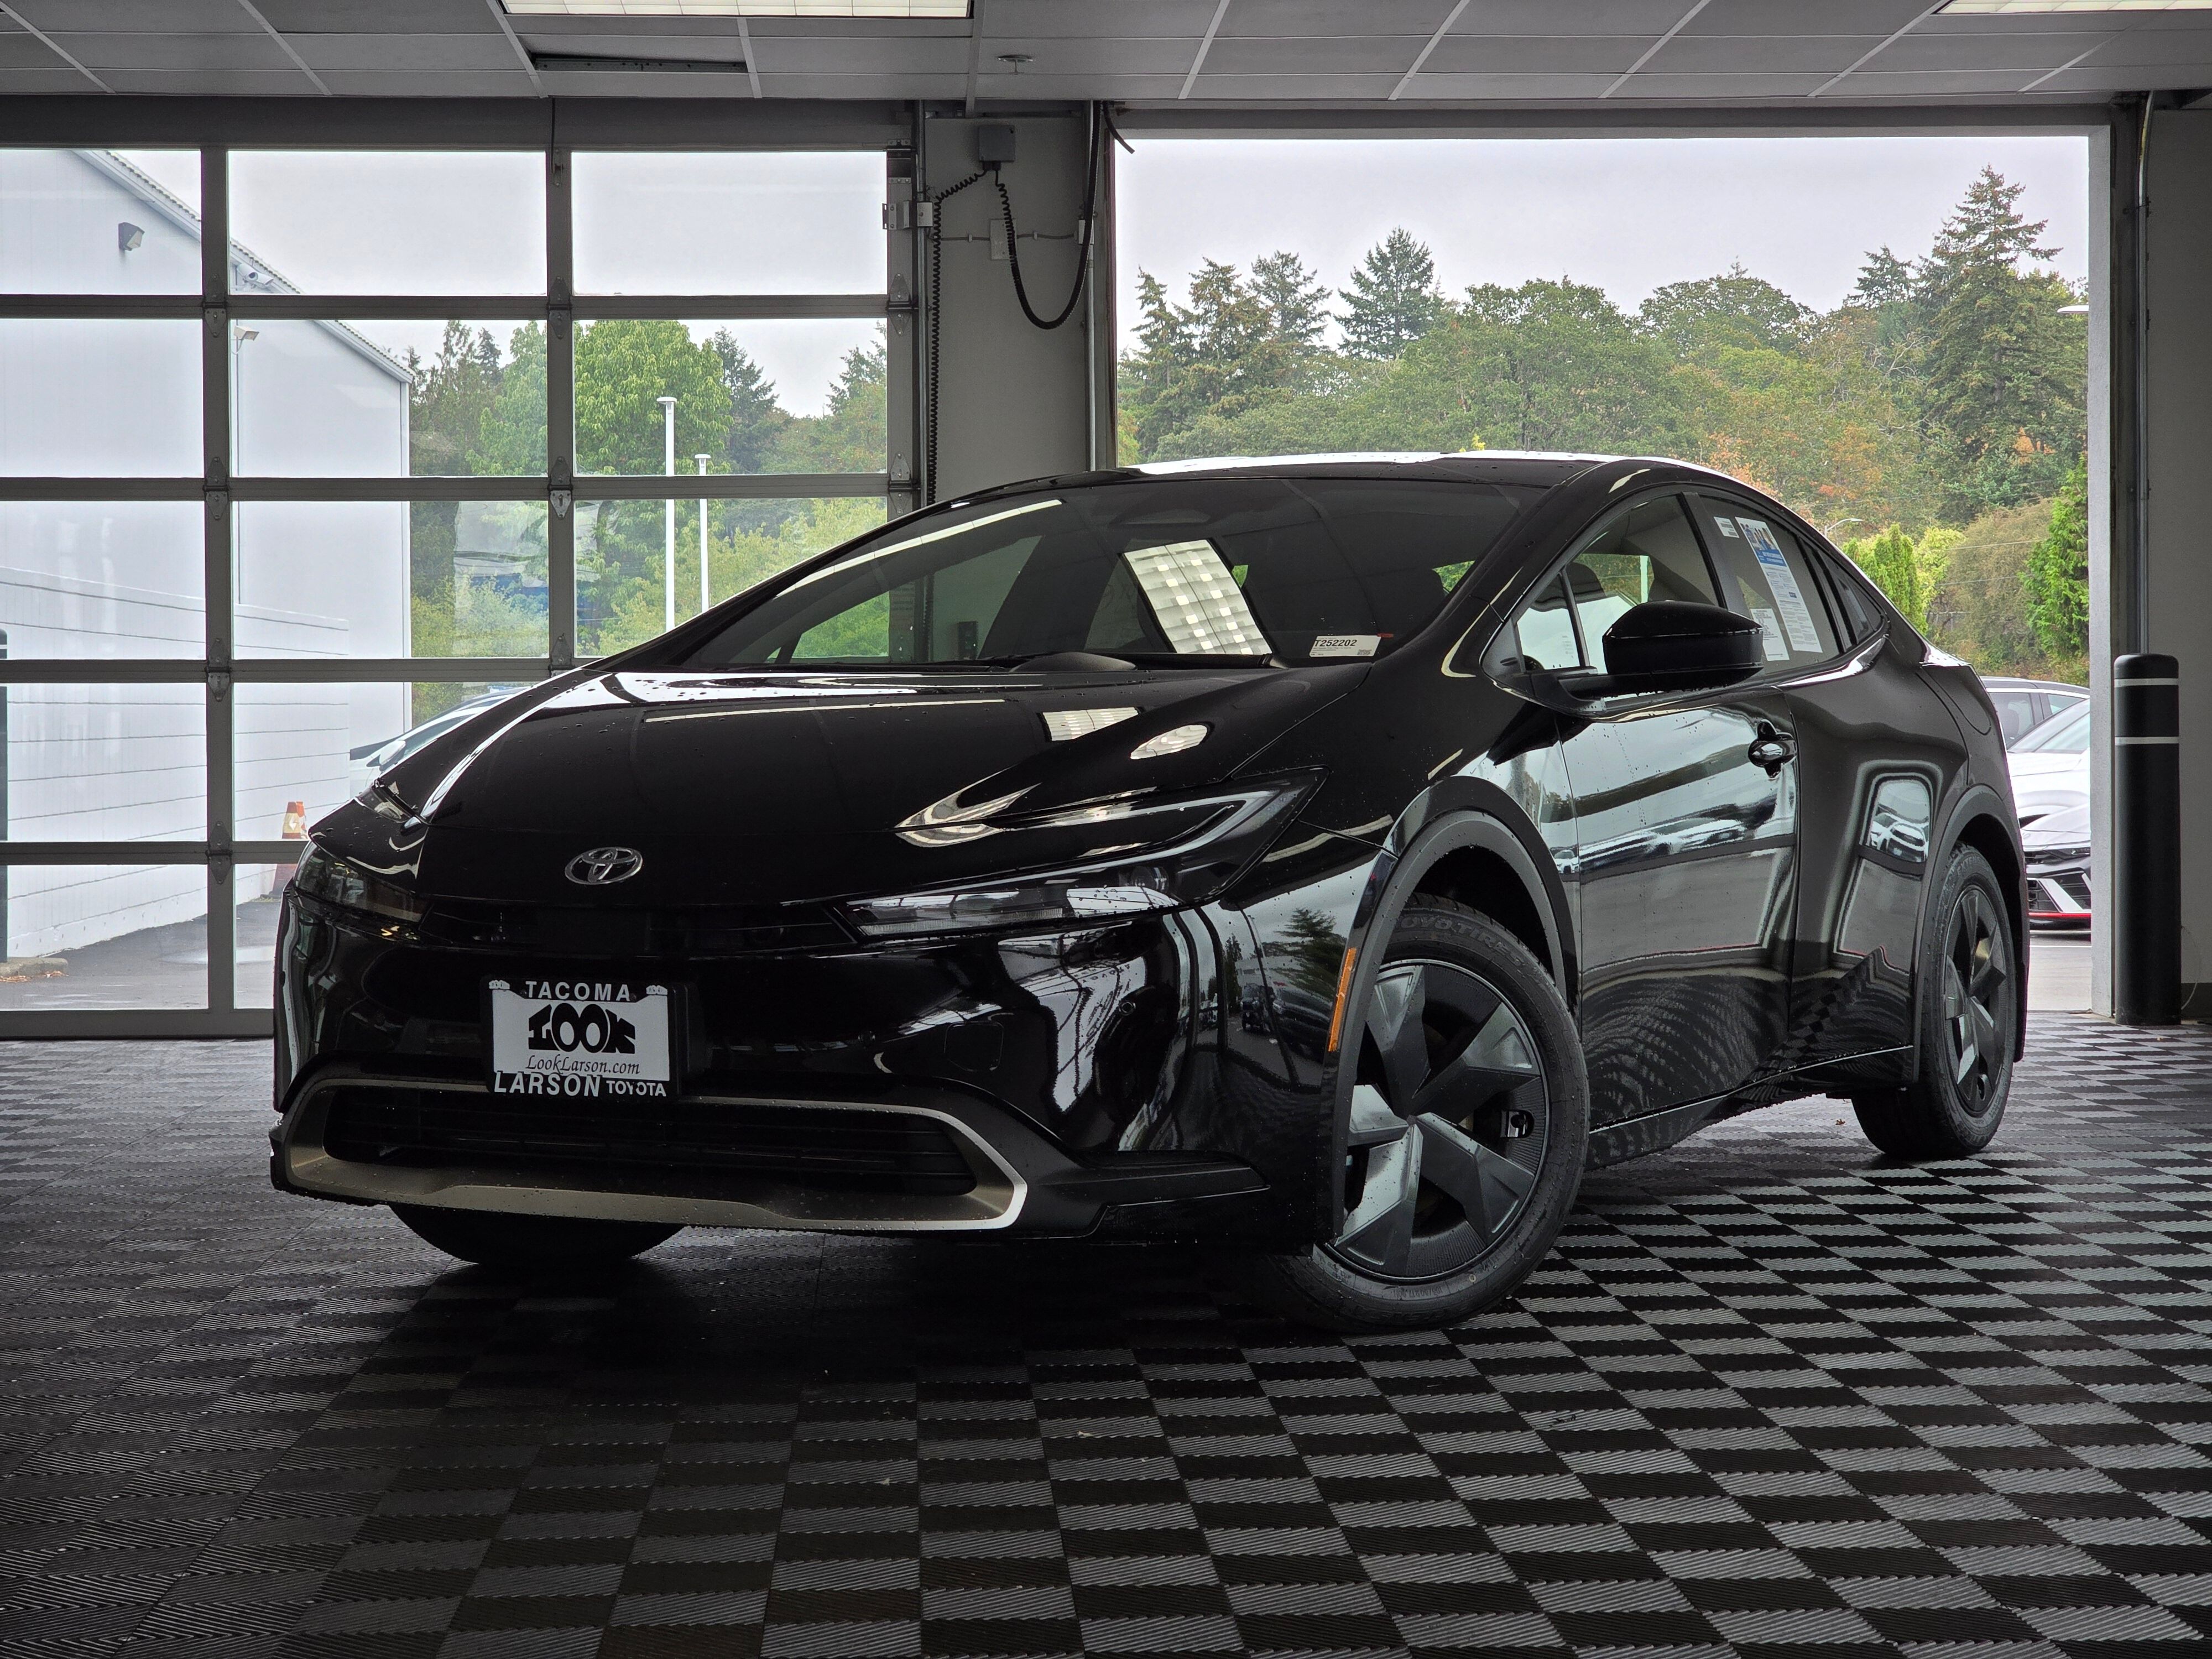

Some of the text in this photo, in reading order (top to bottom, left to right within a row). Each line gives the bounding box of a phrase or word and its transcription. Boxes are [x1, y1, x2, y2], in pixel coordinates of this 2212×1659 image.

[1400, 915, 1453, 930] OYO
[525, 980, 630, 1001] TACOMA
[528, 1002, 636, 1054] LOOK
[525, 1053, 640, 1074] LookLarson.com
[494, 1071, 667, 1097] LARSON TOYOTA
